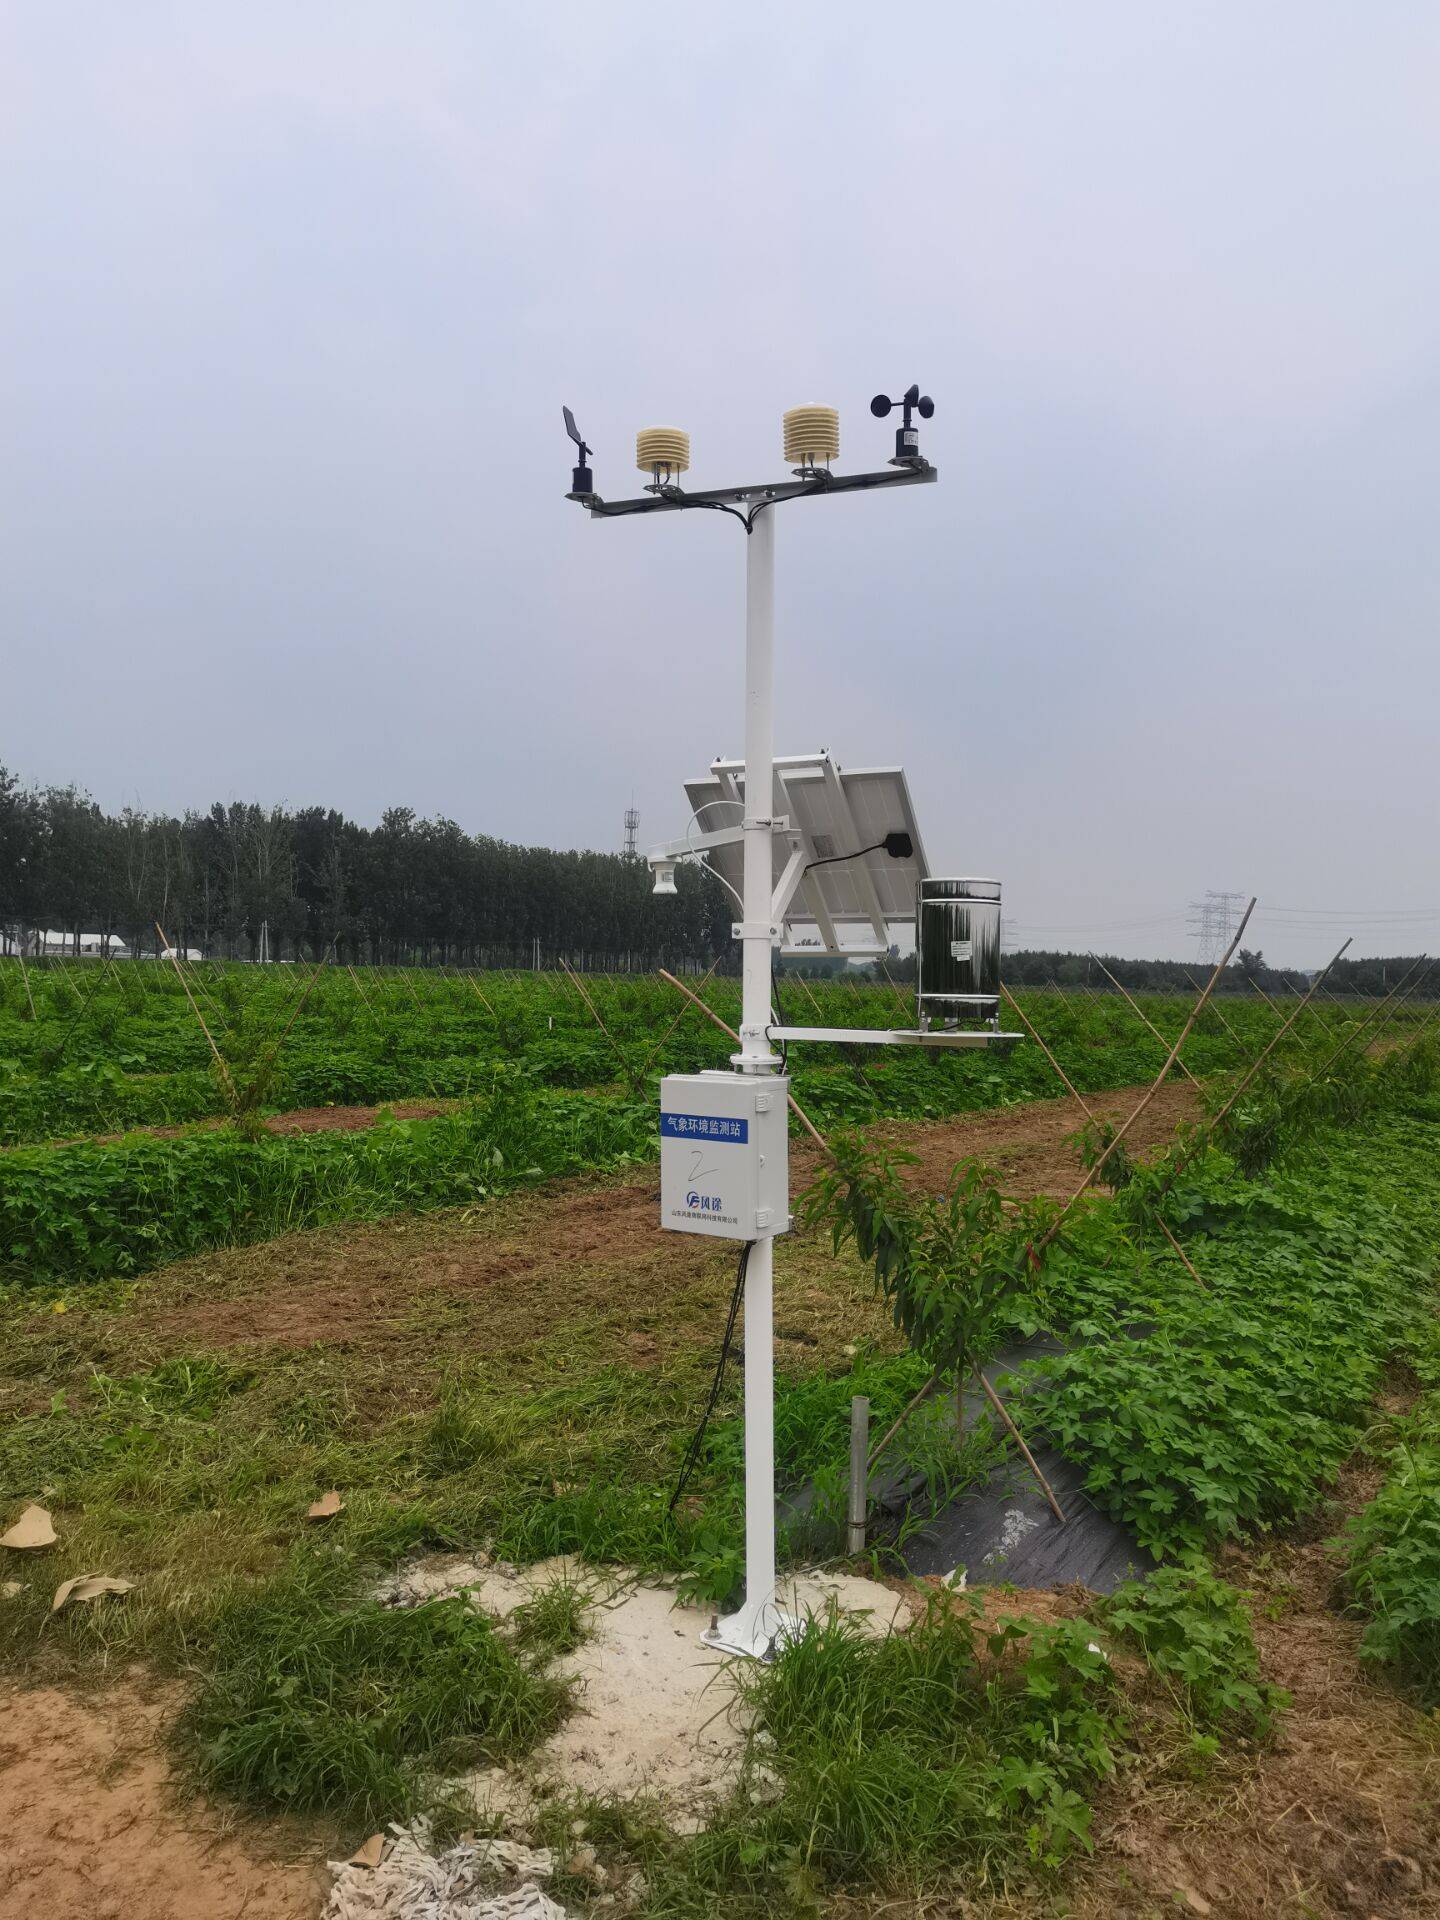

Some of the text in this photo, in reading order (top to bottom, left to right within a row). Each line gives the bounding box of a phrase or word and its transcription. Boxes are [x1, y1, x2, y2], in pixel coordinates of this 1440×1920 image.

[667, 1116, 741, 1137] 气象环境监测站
[688, 1150, 720, 1182] 2
[701, 1195, 722, 1211] 风途
